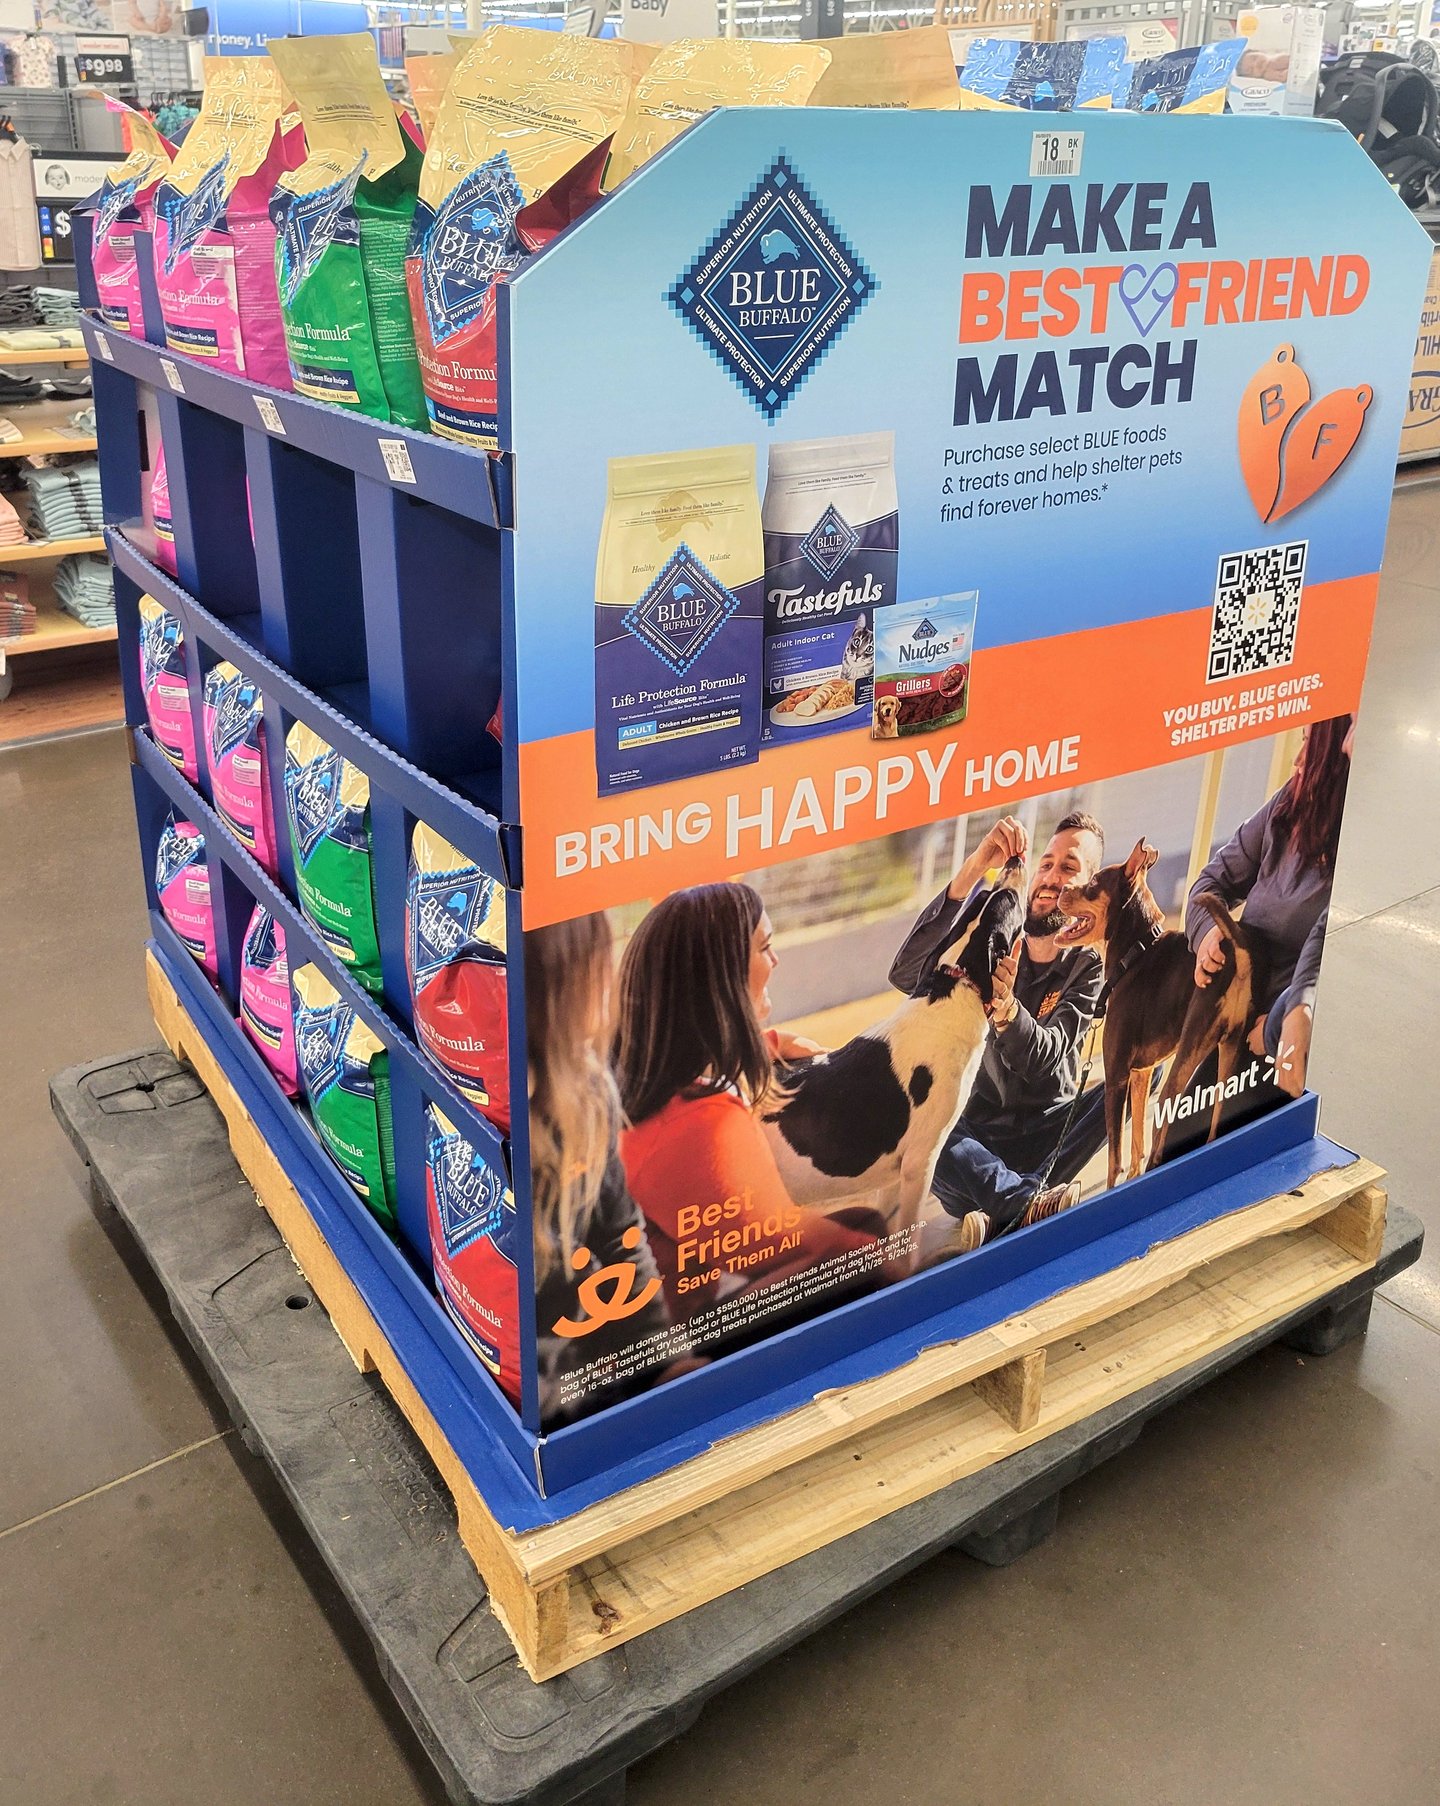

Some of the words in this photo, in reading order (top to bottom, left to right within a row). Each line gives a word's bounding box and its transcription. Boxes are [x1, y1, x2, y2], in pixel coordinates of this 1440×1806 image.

[1042, 138, 1059, 161] 18
[1068, 138, 1078, 148] BK
[1070, 149, 1074, 158] 1
[298, 198, 331, 214] SUPERIOR
[454, 178, 490, 204] NUTRITION
[696, 239, 734, 285] SUPERIOR
[732, 190, 773, 239] NUTRITION
[787, 189, 818, 230] ULTIMATE
[814, 227, 852, 278] PROTECTION
[964, 183, 1168, 258] MAKE
[1168, 182, 1217, 249] A
[729, 268, 821, 306] BLUE
[959, 266, 1125, 344] BEST
[1171, 254, 1371, 327] FRIEND
[304, 322, 352, 341] Formula
[695, 305, 727, 344] ULTIMATE
[724, 340, 766, 389] PROTECTION
[780, 343, 816, 387] SUPERIOR
[814, 297, 852, 344] NUTRITION
[451, 360, 497, 381] Formu
[953, 340, 1198, 426] MATCH
[1259, 385, 1283, 426] B
[1408, 386, 1440, 413] GRA
[454, 416, 469, 426] Brown
[469, 419, 481, 429] Rice
[1311, 424, 1338, 459] F
[943, 444, 1024, 467] Purchase
[1029, 436, 1079, 458] select
[1083, 430, 1120, 450] BLUE
[1123, 425, 1167, 445] foods
[942, 477, 954, 494] &
[958, 471, 1009, 493] treats
[1014, 468, 1047, 486] and
[1052, 463, 1088, 484] help
[1091, 456, 1145, 478] shelter
[1148, 451, 1183, 475] pets
[940, 503, 974, 522] find
[977, 495, 1039, 517] forever
[709, 553, 731, 562] Holistic
[817, 534, 843, 549] BLUE
[632, 564, 655, 574] Healthy
[686, 562, 702, 582] ULTIMATE
[702, 578, 724, 601] PROTECTION
[640, 590, 660, 614] SUPERIOR
[658, 564, 679, 592] NUTRITION
[767, 572, 882, 619] Tastefuls
[658, 598, 707, 622] BLUE
[639, 623, 658, 642] ULTIMATE
[656, 638, 678, 660] PROTECTION
[686, 634, 705, 657] SUPERIOR
[704, 610, 724, 635] NUTRITION
[772, 639, 793, 650] Adult
[794, 636, 820, 646] Indoor
[822, 632, 835, 640] Cat
[899, 640, 950, 662] Nudges
[612, 694, 636, 709] Life
[638, 684, 696, 704] Protection
[700, 674, 747, 691] Formula
[664, 696, 698, 707] LifeSource
[896, 678, 931, 692] Grillers
[1162, 704, 1199, 728] YOU
[1200, 694, 1236, 719] BUY.
[1239, 684, 1276, 709] BLUE
[1278, 673, 1324, 696] GIVES.
[622, 724, 653, 738] ADULT
[658, 721, 680, 729] Chicken
[722, 708, 739, 716] Recipe
[1170, 716, 1237, 746] SHELTER
[1238, 704, 1275, 728] PETS
[1278, 696, 1312, 718] WIN.
[555, 801, 713, 877] BRING
[726, 742, 959, 858] HAPPY
[964, 735, 1081, 798] HOME
[418, 881, 449, 891] SUPERIOR
[448, 873, 480, 886] NUTRITION
[172, 908, 208, 926] Formula
[314, 886, 352, 918] Formula
[428, 1023, 486, 1052] Formula
[1154, 1060, 1260, 1129] Walmart
[446, 1160, 490, 1208] BLUE
[446, 1181, 477, 1216] BUFFALO
[678, 1187, 755, 1238] Best
[678, 1205, 801, 1273] Friends
[677, 1271, 721, 1295] Save
[726, 1246, 775, 1274] Them
[779, 1232, 800, 1253] All
[461, 1283, 503, 1328] Formula
[560, 1378, 580, 1394] bag
[582, 1373, 590, 1384] of
[592, 1364, 613, 1378] BLUE
[614, 1348, 655, 1369] Tastefuls
[656, 1338, 672, 1352] dry
[672, 1334, 688, 1344] cat
[688, 1324, 709, 1337] food
[710, 1320, 720, 1330] or
[721, 1310, 740, 1324] BLUE
[742, 1304, 756, 1314] Life
[757, 1285, 798, 1307] Protection
[800, 1270, 832, 1290] Formula
[833, 1262, 846, 1276] dry
[848, 1256, 864, 1269] dog
[884, 1242, 900, 1253] and
[900, 1236, 912, 1246] for
[586, 1352, 618, 1371] Buffalo
[620, 1344, 634, 1356] will
[636, 1330, 668, 1350] donate
[688, 1316, 703, 1328] (up
[706, 1310, 716, 1319] to
[716, 1290, 758, 1316] $550,000)
[760, 1288, 769, 1296] to
[770, 1279, 788, 1292] Best
[789, 1266, 818, 1285] Friends
[819, 1256, 847, 1270] Animal
[848, 1240, 876, 1259] Society
[876, 1237, 887, 1246] for
[888, 1228, 910, 1241] every
[560, 1388, 586, 1405] every
[588, 1376, 614, 1392] 16-oz.
[616, 1366, 635, 1380] bag
[636, 1360, 646, 1371] of
[646, 1352, 667, 1366] BLUE
[668, 1338, 702, 1358] Nudges
[704, 1328, 721, 1344] dog
[722, 1318, 747, 1334] treats
[748, 1298, 793, 1324] purchased
[794, 1292, 803, 1303] at
[804, 1278, 838, 1298] Walmart
[839, 1269, 858, 1282] from
